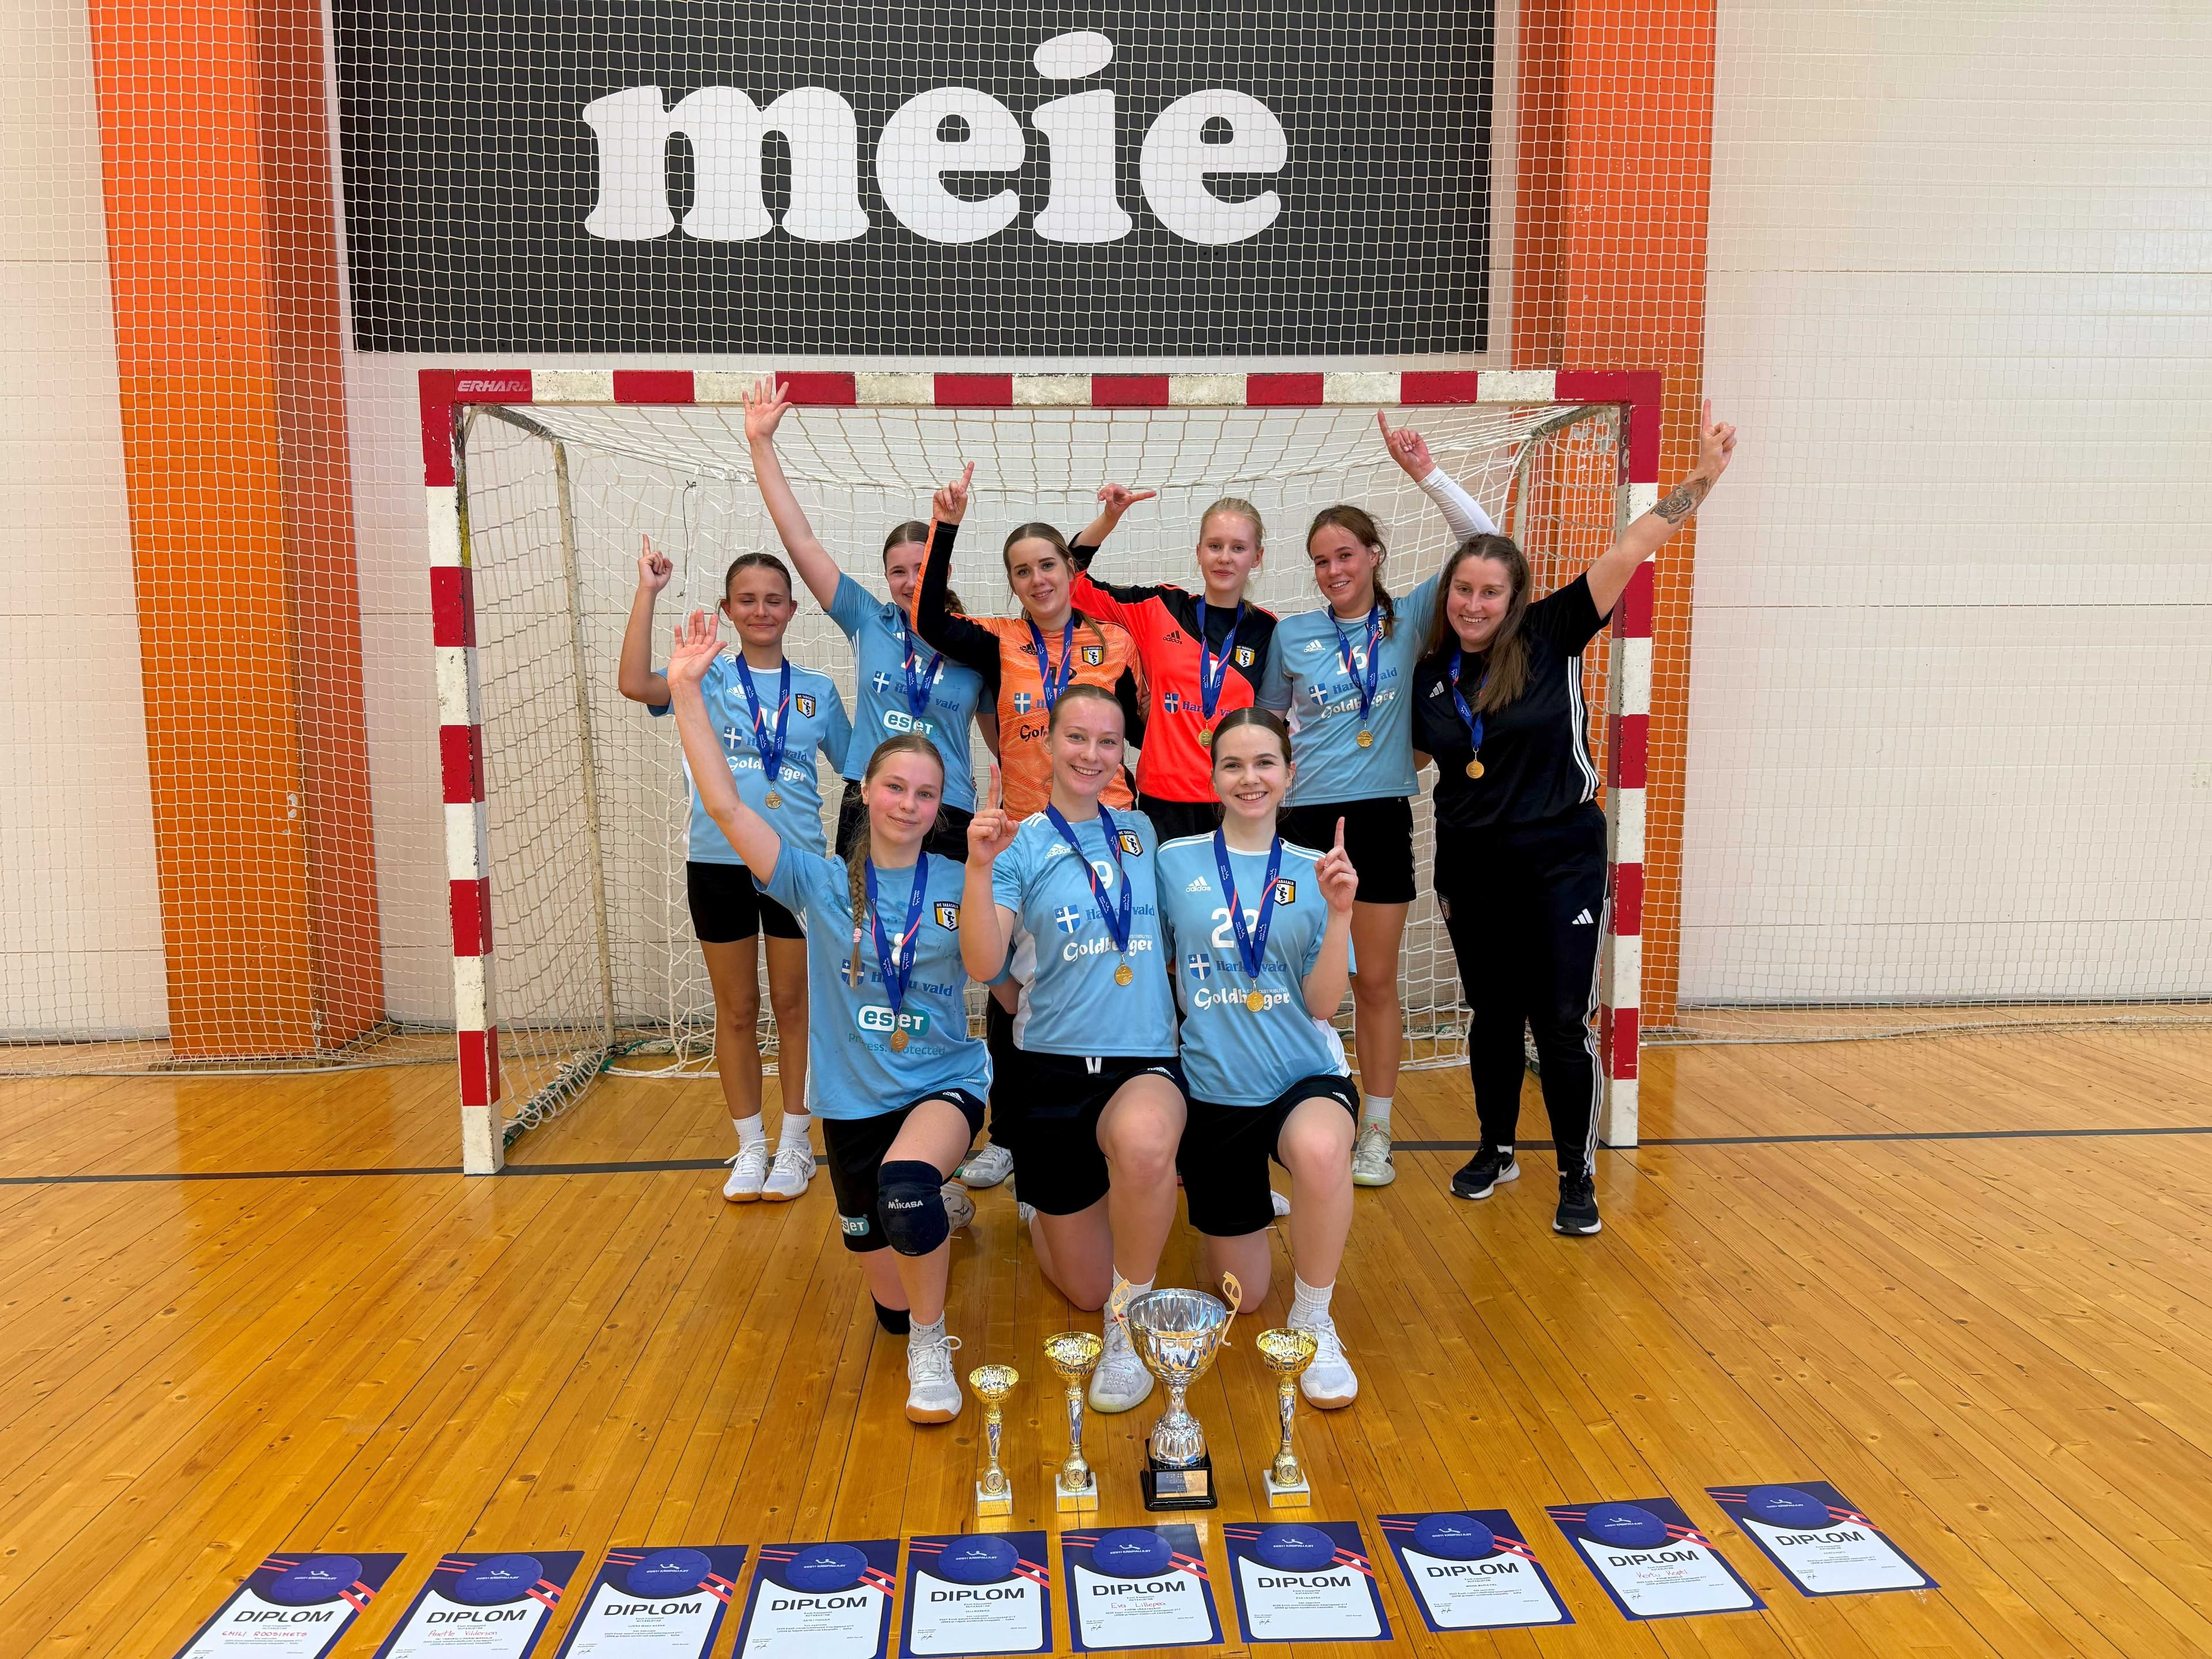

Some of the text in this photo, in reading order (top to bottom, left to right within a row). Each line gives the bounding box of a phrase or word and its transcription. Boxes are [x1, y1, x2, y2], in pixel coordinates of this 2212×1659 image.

[583, 31, 1288, 244] meie
[1335, 645, 1367, 675] 16
[1090, 861, 1113, 889] 9
[923, 982, 953, 997] vald
[1775, 1531, 1865, 1546] DIPLOM
[1608, 1550, 1700, 1567] DIPLOM
[1426, 1562, 1519, 1577] DIPLOM
[1092, 1581, 1185, 1596] DIPLOM
[1258, 1576, 1351, 1588] DIPLOM
[931, 1588, 1024, 1602] DIPLOM
[604, 1603, 702, 1616] DIPLOM
[771, 1596, 867, 1611] DIPLOM
[233, 1611, 335, 1622] DIPLOM
[426, 1609, 527, 1623] DIPLOM
